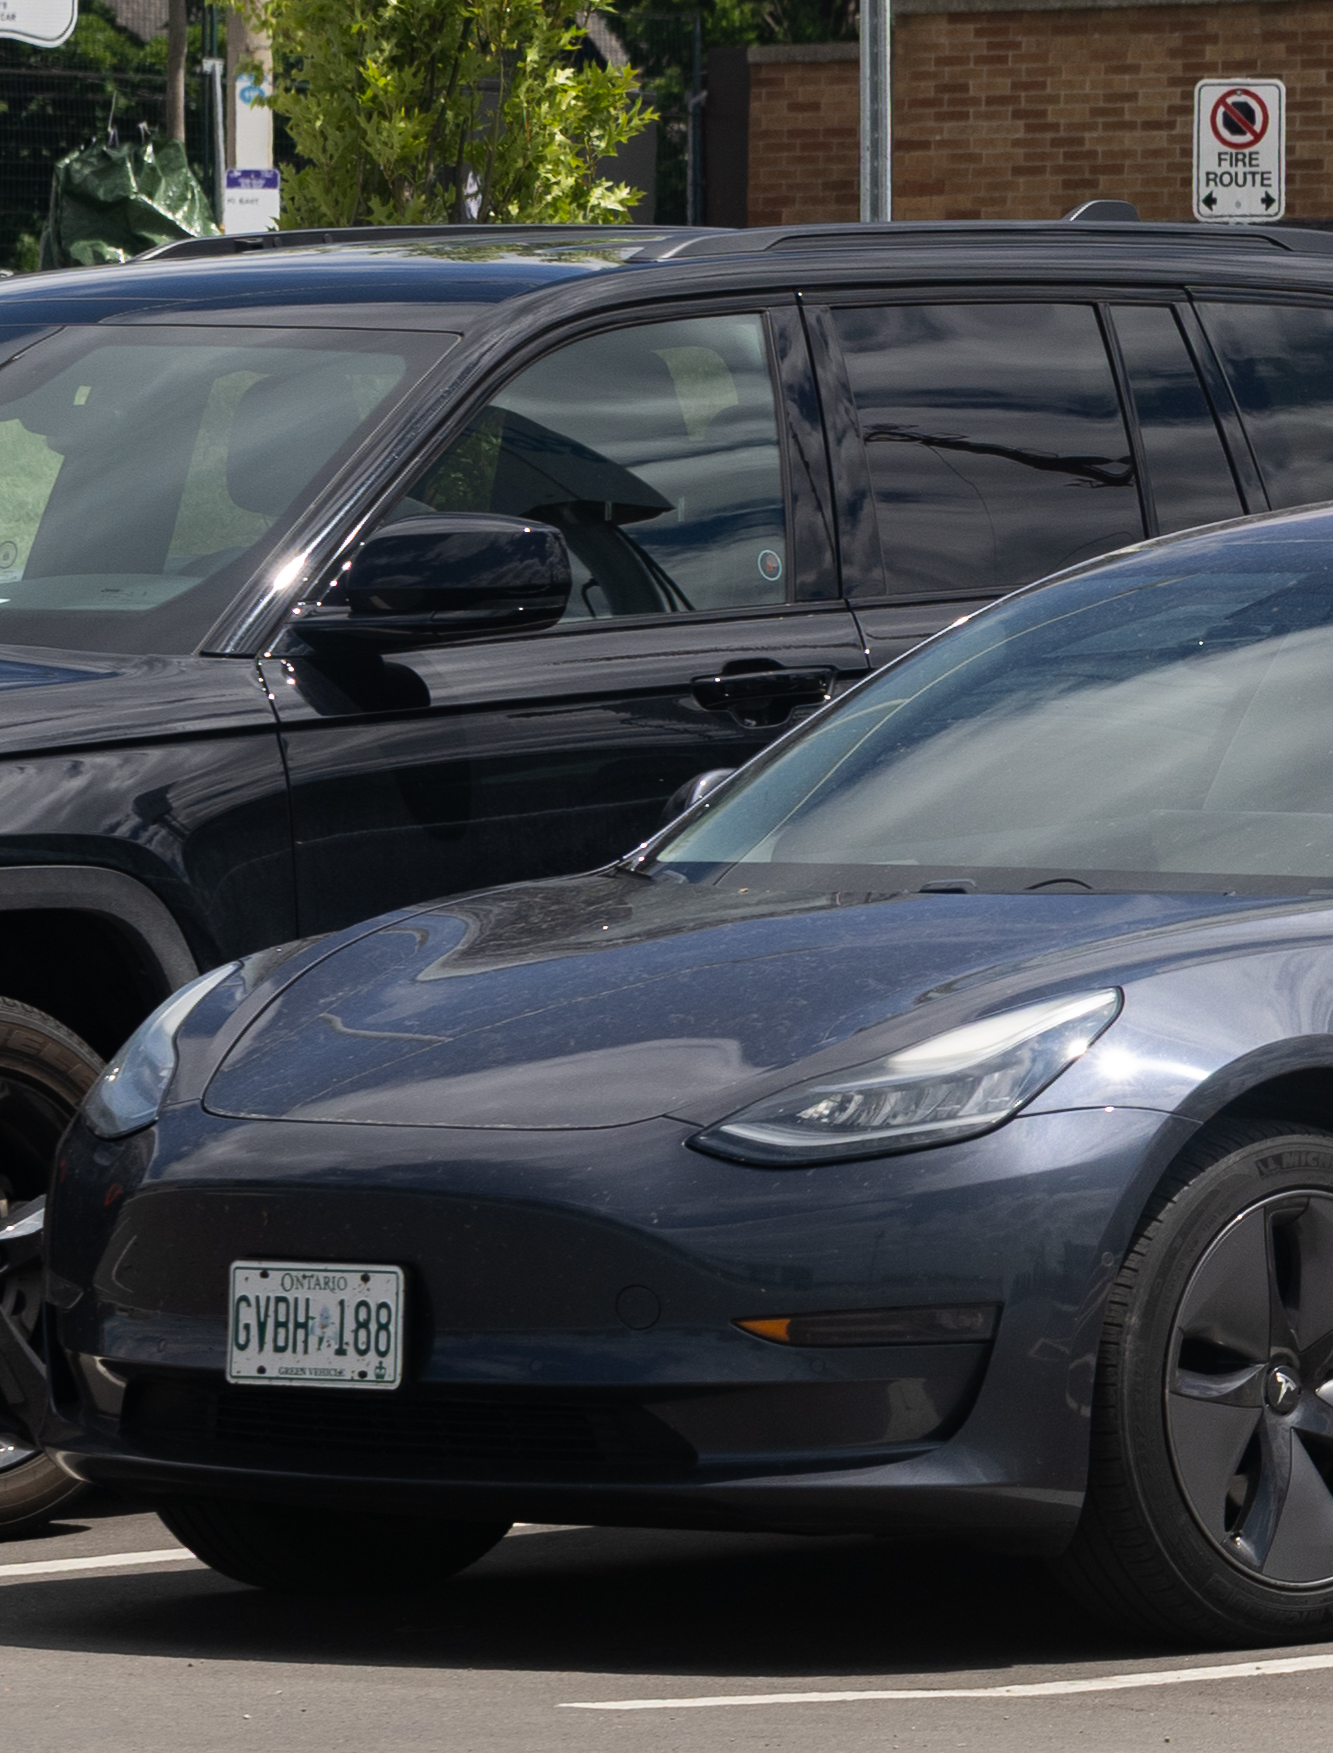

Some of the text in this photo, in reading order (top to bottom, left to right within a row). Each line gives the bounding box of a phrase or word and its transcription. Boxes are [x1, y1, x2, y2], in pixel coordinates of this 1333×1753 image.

[1217, 151, 1260, 168] FIRE
[1205, 171, 1272, 188] ROUTE
[280, 1272, 348, 1293] ONTARIO
[234, 1294, 393, 1358] GVBH 188
[278, 1366, 345, 1377] GREEN VEHICLE
